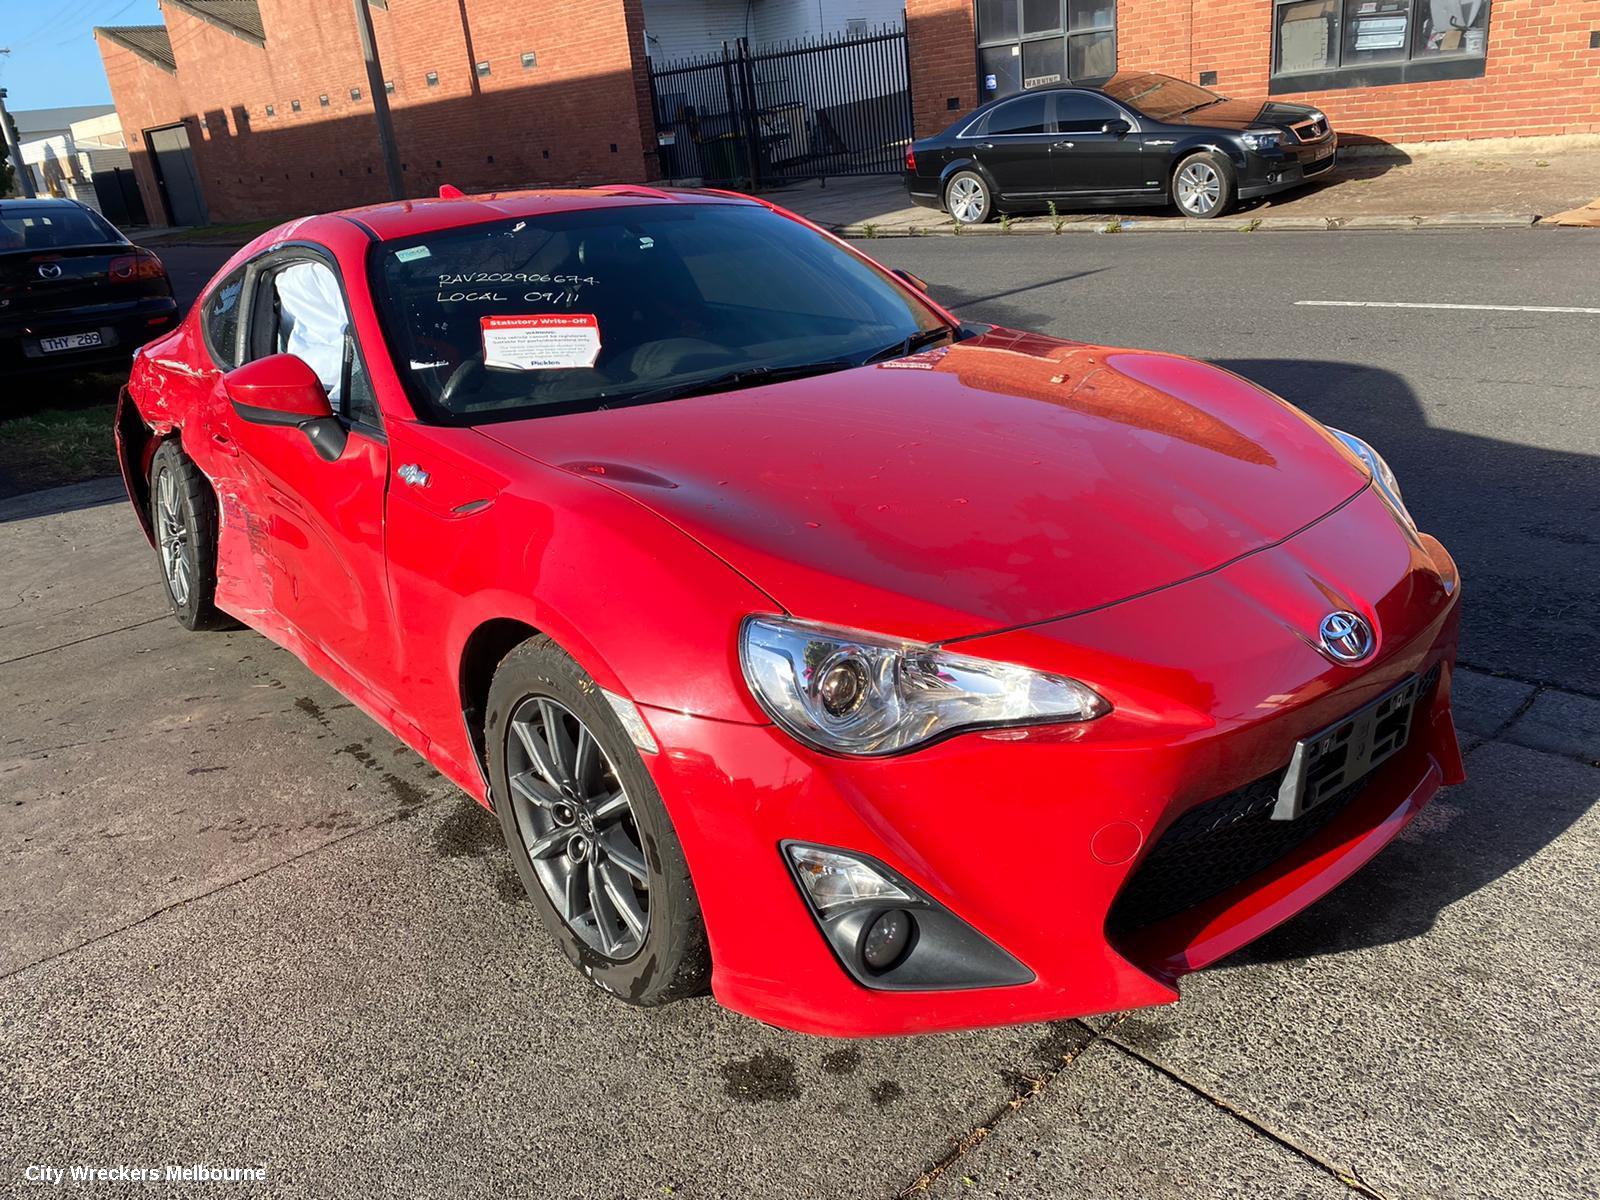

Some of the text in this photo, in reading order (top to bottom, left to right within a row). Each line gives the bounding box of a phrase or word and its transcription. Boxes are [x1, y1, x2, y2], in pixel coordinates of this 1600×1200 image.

[437, 292, 507, 302] LOCAL
[490, 317, 588, 327] Statutory Write-Off
[46, 333, 100, 350] THY 289
